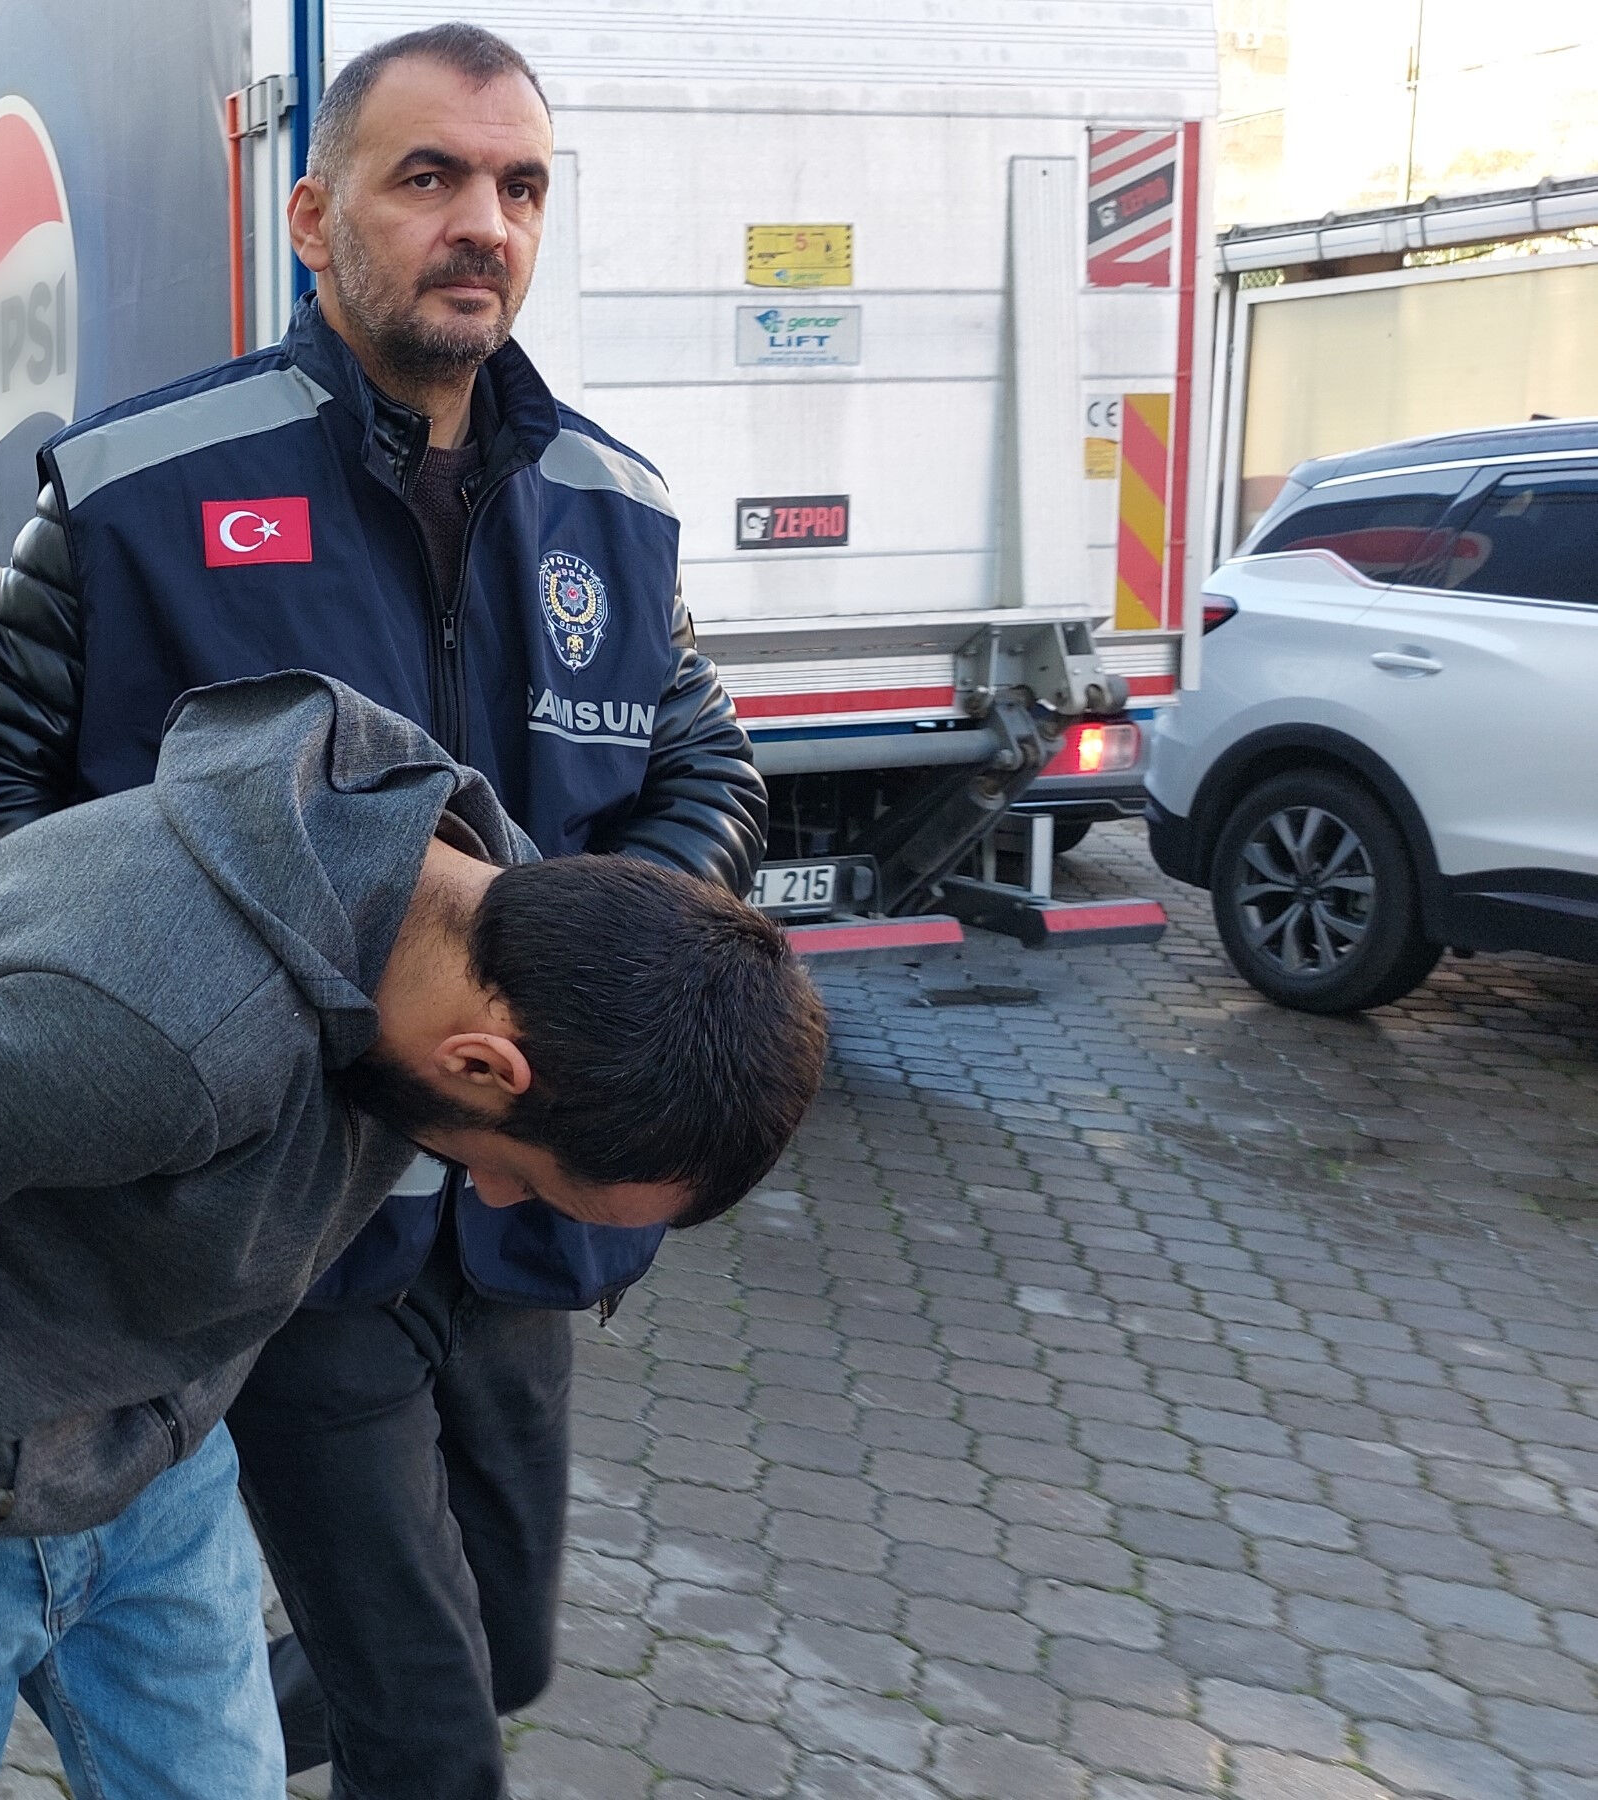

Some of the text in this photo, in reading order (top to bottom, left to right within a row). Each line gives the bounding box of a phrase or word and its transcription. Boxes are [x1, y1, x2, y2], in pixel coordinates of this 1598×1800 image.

[1087, 401, 1118, 428] CE
[773, 506, 845, 539] ZEPRO
[781, 868, 830, 902] 215
